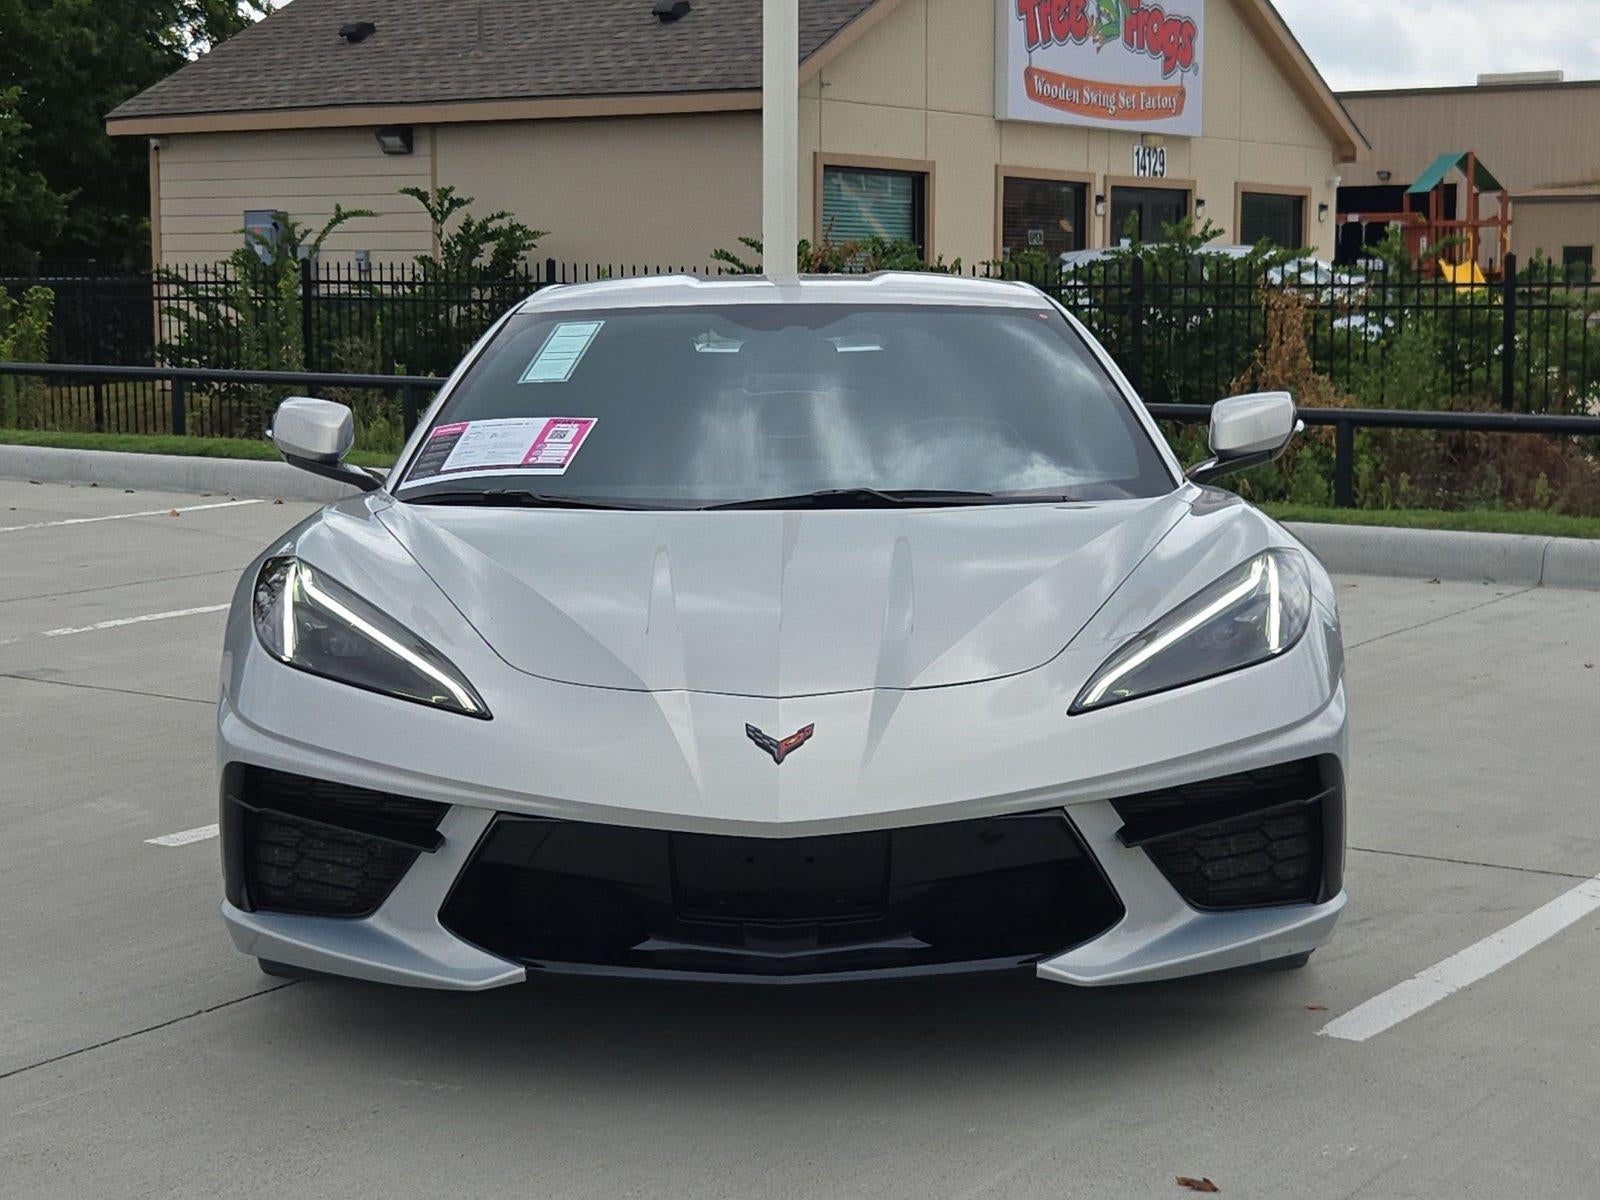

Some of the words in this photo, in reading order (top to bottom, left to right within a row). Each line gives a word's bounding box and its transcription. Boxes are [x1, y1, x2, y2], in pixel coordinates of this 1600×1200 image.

[1016, 0, 1089, 51] Tree
[1034, 76, 1079, 104] Wooden
[1083, 87, 1116, 115] Swing
[1119, 90, 1136, 110] Set
[1141, 92, 1177, 113] Factory
[1135, 147, 1165, 178] 14129
